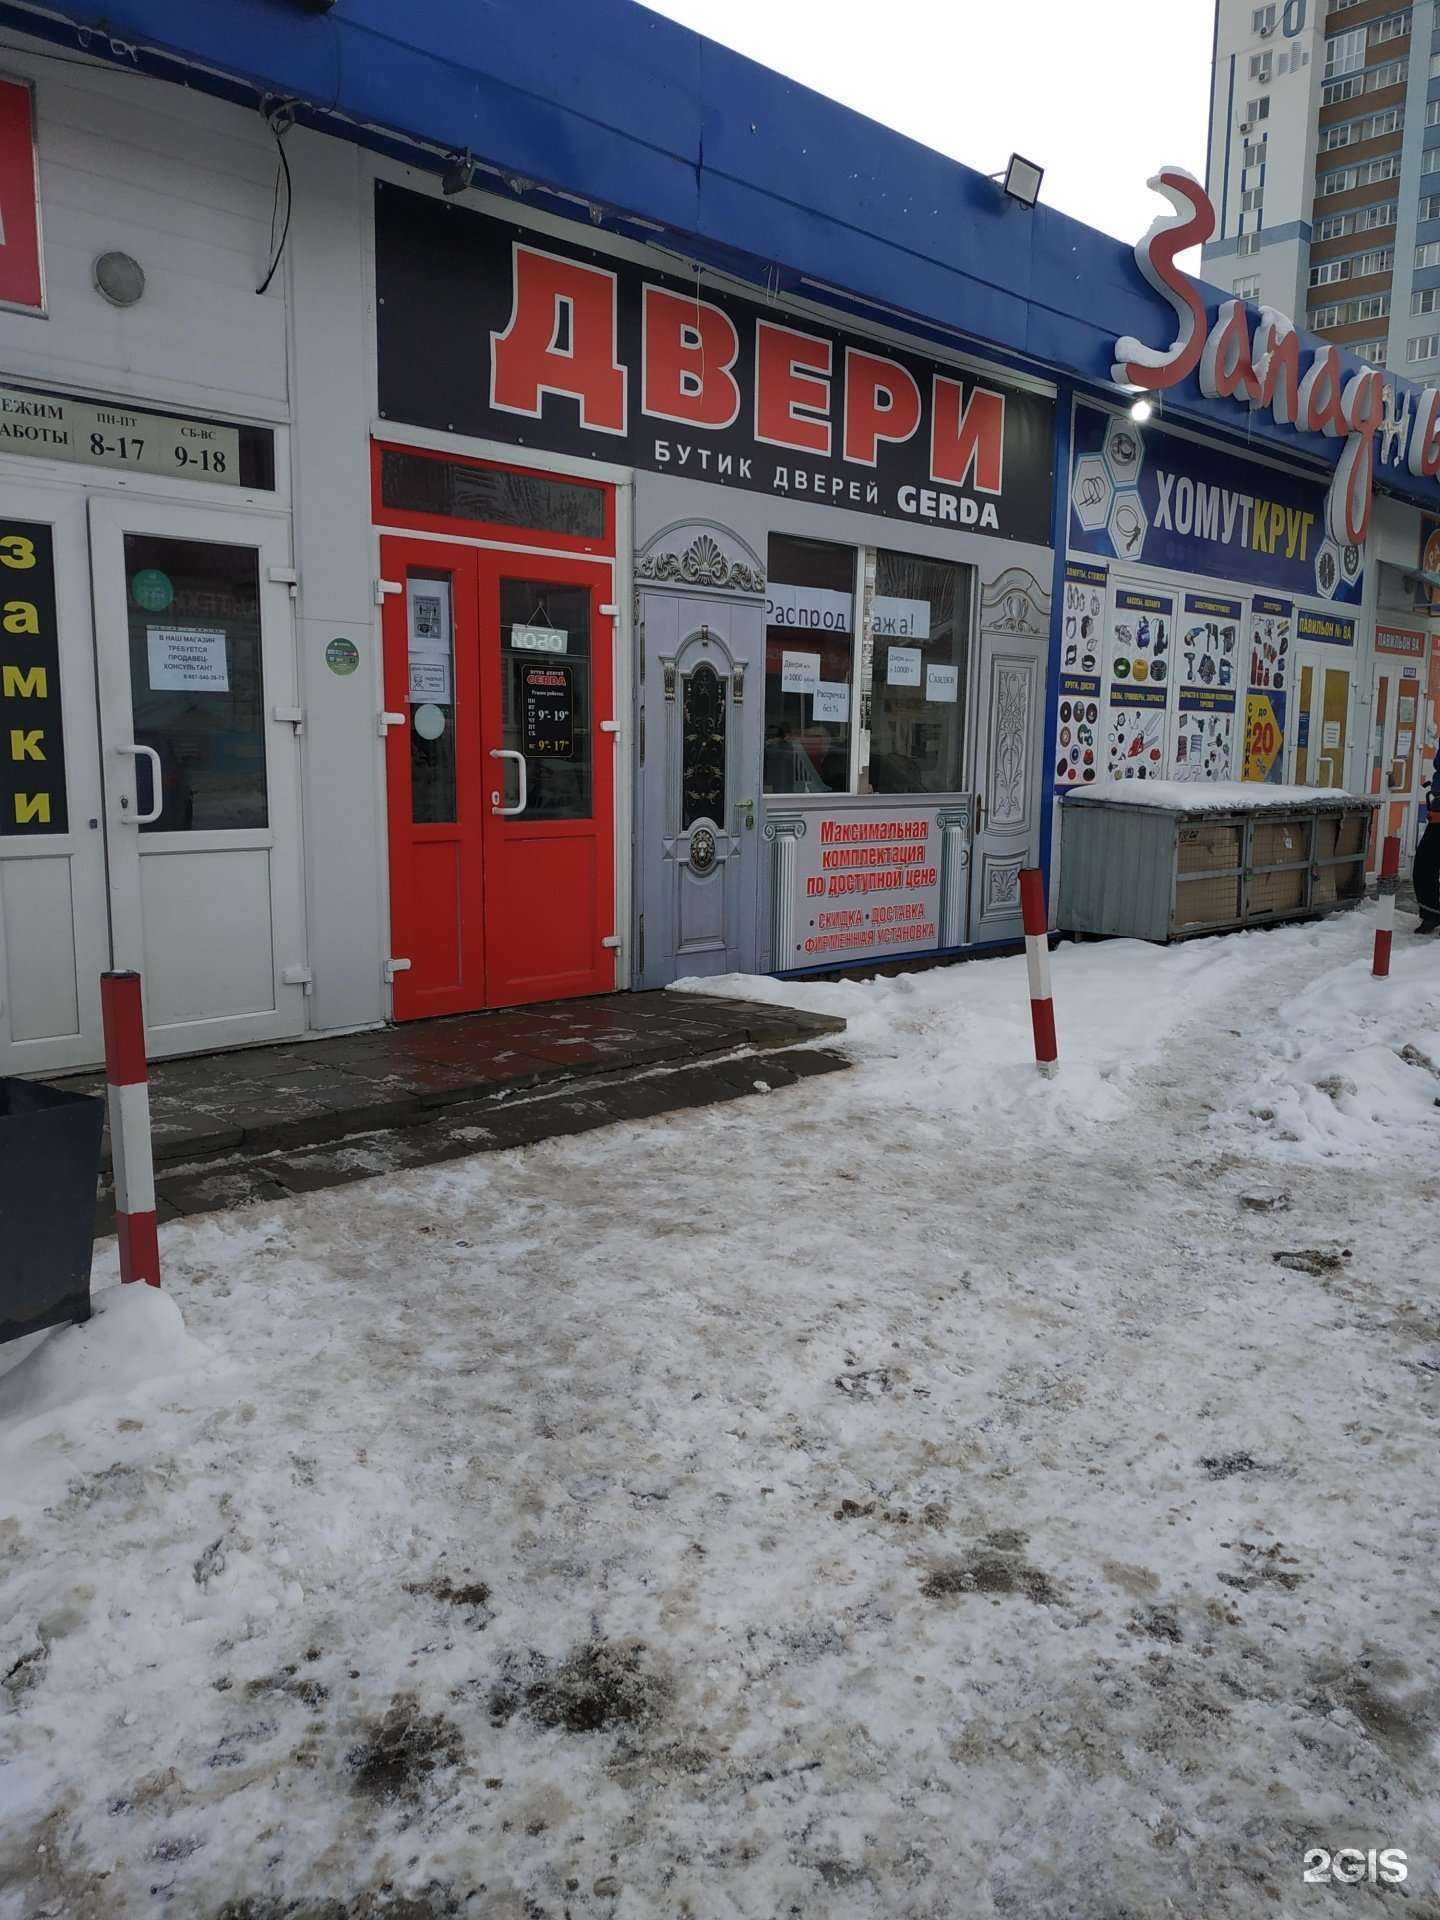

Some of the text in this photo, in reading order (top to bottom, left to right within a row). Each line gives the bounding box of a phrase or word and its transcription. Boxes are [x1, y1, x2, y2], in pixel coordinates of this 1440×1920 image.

[489, 241, 1006, 496] ДВЕРИ
[97, 412, 138, 428] ПН-ПТ
[180, 426, 217, 441] СБ-ВС
[89, 432, 145, 461] 8-17
[174, 445, 227, 474] 9-18
[654, 439, 1001, 530] БУТИК ДВЕРЕЙ GERDA
[184, 635, 215, 643] МАГАЗИН
[1300, 617, 1334, 637] ПАВИЛЬОН
[168, 645, 208, 653] ТРЕБУЕТСЯ
[163, 664, 213, 672] КОНСУЛЬТАНТ
[1252, 721, 1275, 756] 20
[820, 820, 929, 844] Максимальная
[822, 845, 926, 869] комплектация
[806, 866, 937, 898] по доступной цене
[818, 903, 925, 929] СКИДКА ДОСТАВКА
[804, 922, 936, 955] ФИРМЕННАЯ УСТАНОВКА
